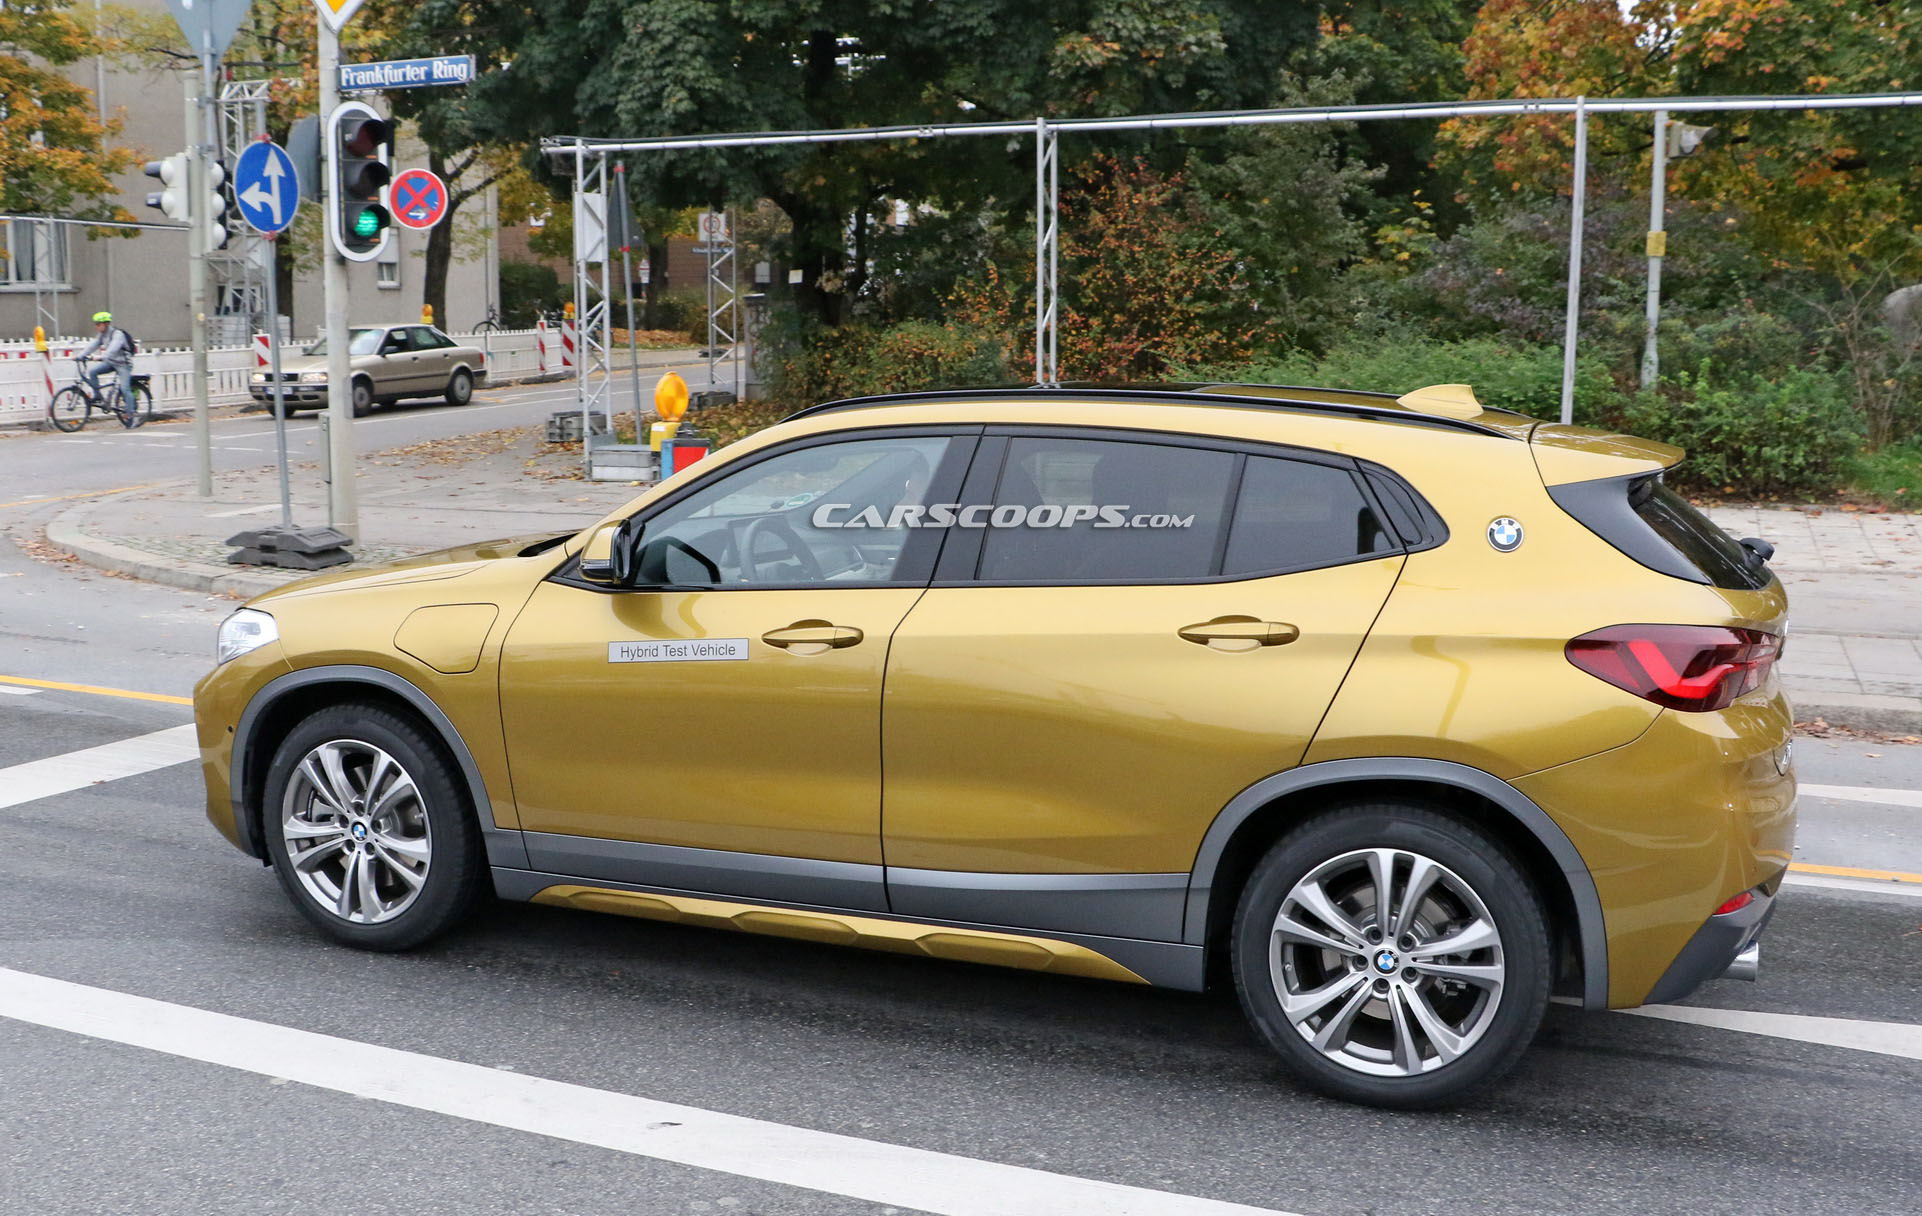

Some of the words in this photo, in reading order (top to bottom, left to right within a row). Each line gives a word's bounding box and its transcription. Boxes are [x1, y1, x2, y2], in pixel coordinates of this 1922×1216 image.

[341, 64, 428, 86] Frankfurter
[432, 60, 468, 80] Ring
[620, 646, 659, 660] Hybrid
[662, 644, 688, 657] Test
[691, 643, 736, 656] Vehicle
